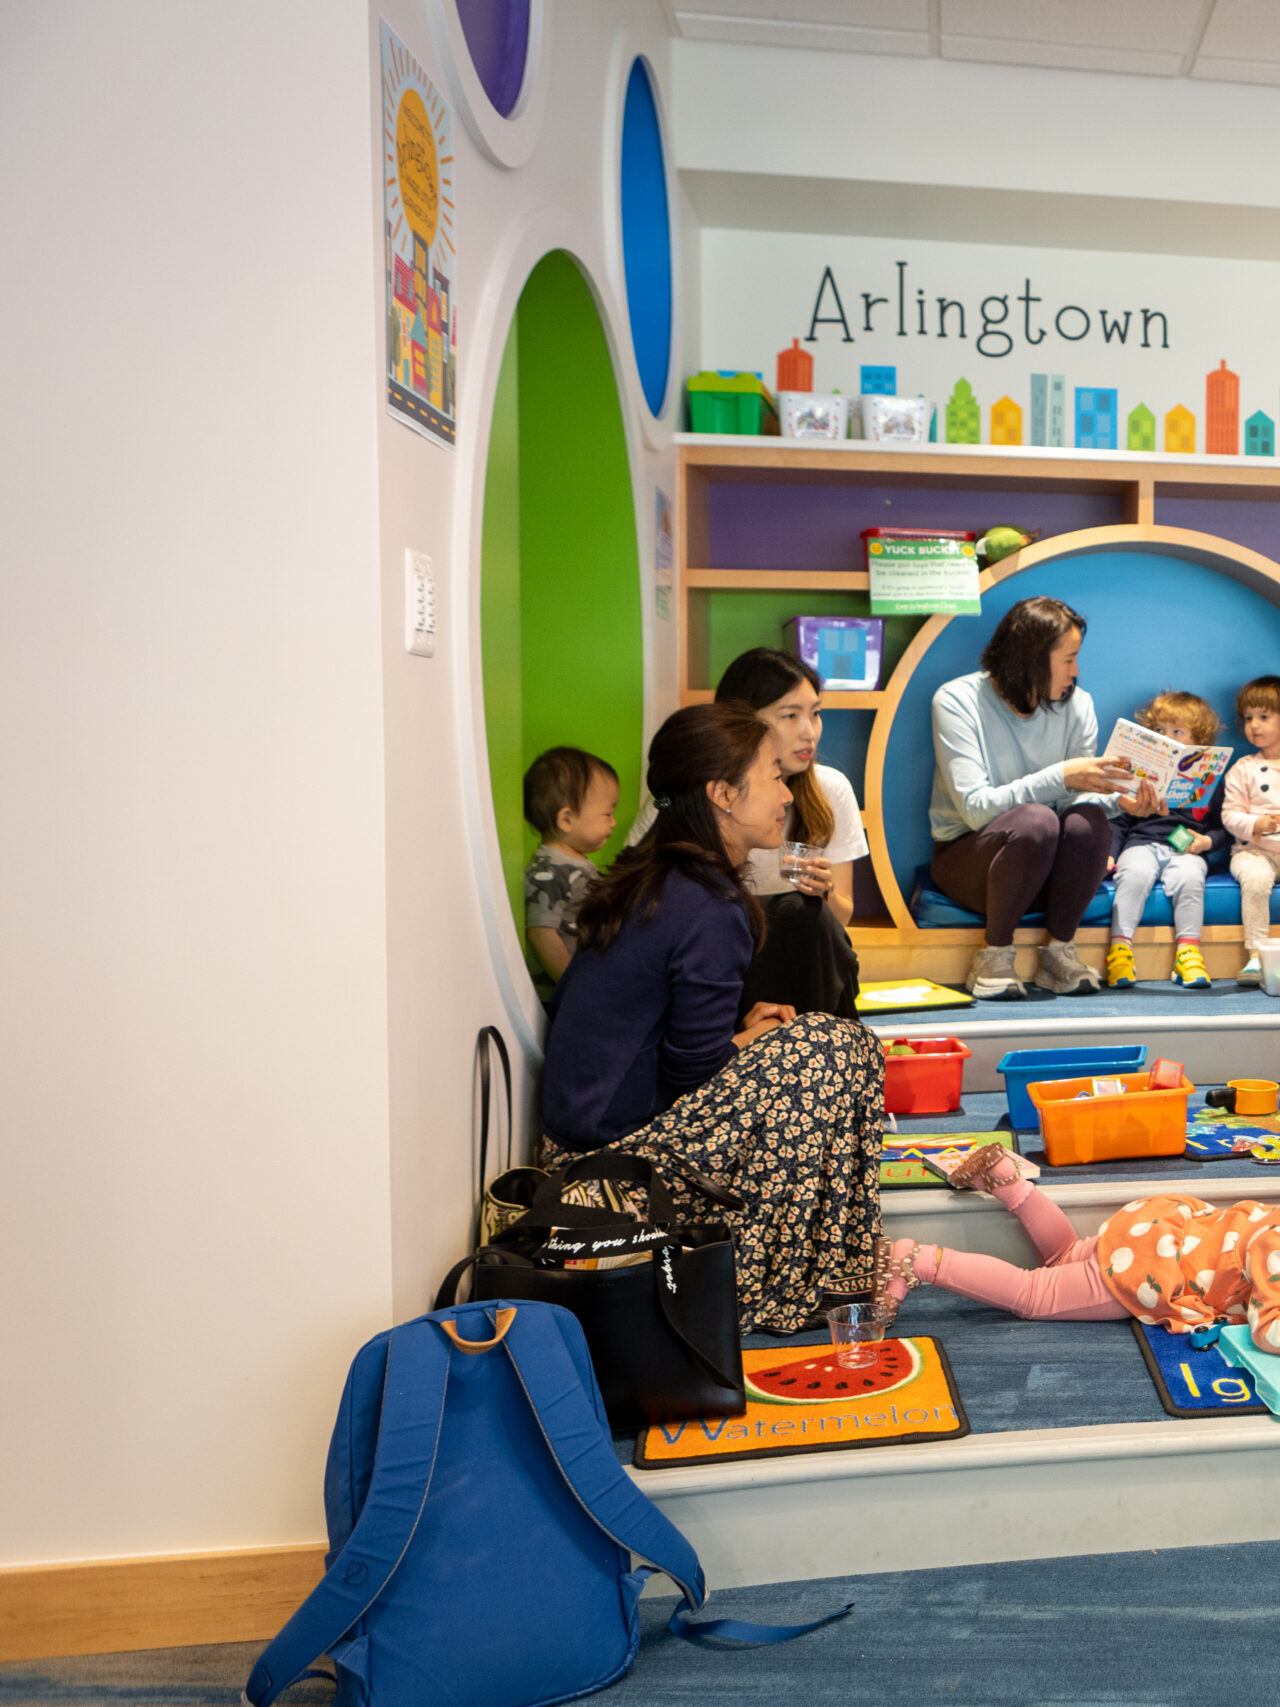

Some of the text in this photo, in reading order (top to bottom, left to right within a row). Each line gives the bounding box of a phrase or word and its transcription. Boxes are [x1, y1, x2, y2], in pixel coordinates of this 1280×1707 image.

[804, 260, 1170, 358] Arlingtown
[884, 545, 961, 555] YUCK BUCKT
[542, 1237, 586, 1254] thing
[592, 1237, 627, 1252] you
[661, 1245, 678, 1294] orget
[658, 1404, 959, 1445] Watermelon
